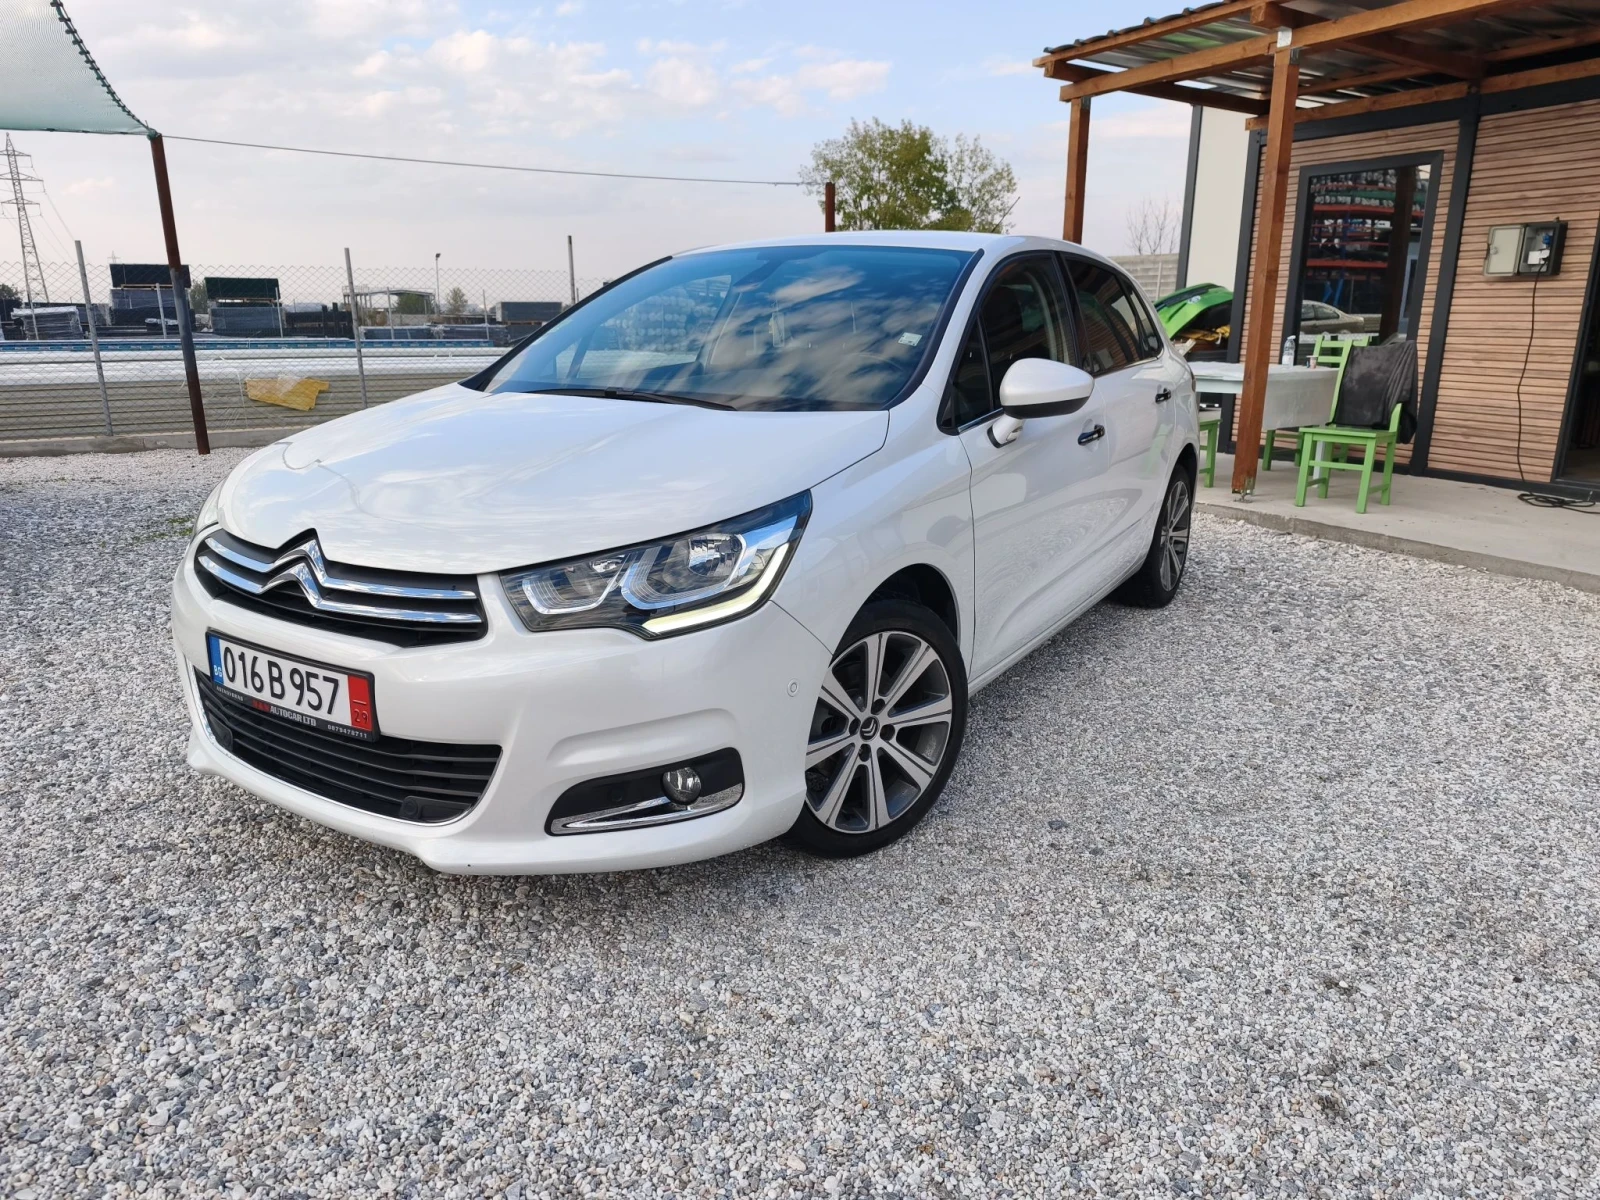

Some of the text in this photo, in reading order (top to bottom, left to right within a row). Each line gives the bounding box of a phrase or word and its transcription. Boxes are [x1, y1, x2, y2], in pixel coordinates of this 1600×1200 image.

[213, 664, 223, 678] BG
[223, 646, 339, 715] 016B957
[270, 705, 303, 723] AUTOCAR
[303, 716, 317, 727] LTD
[353, 708, 369, 725] 29
